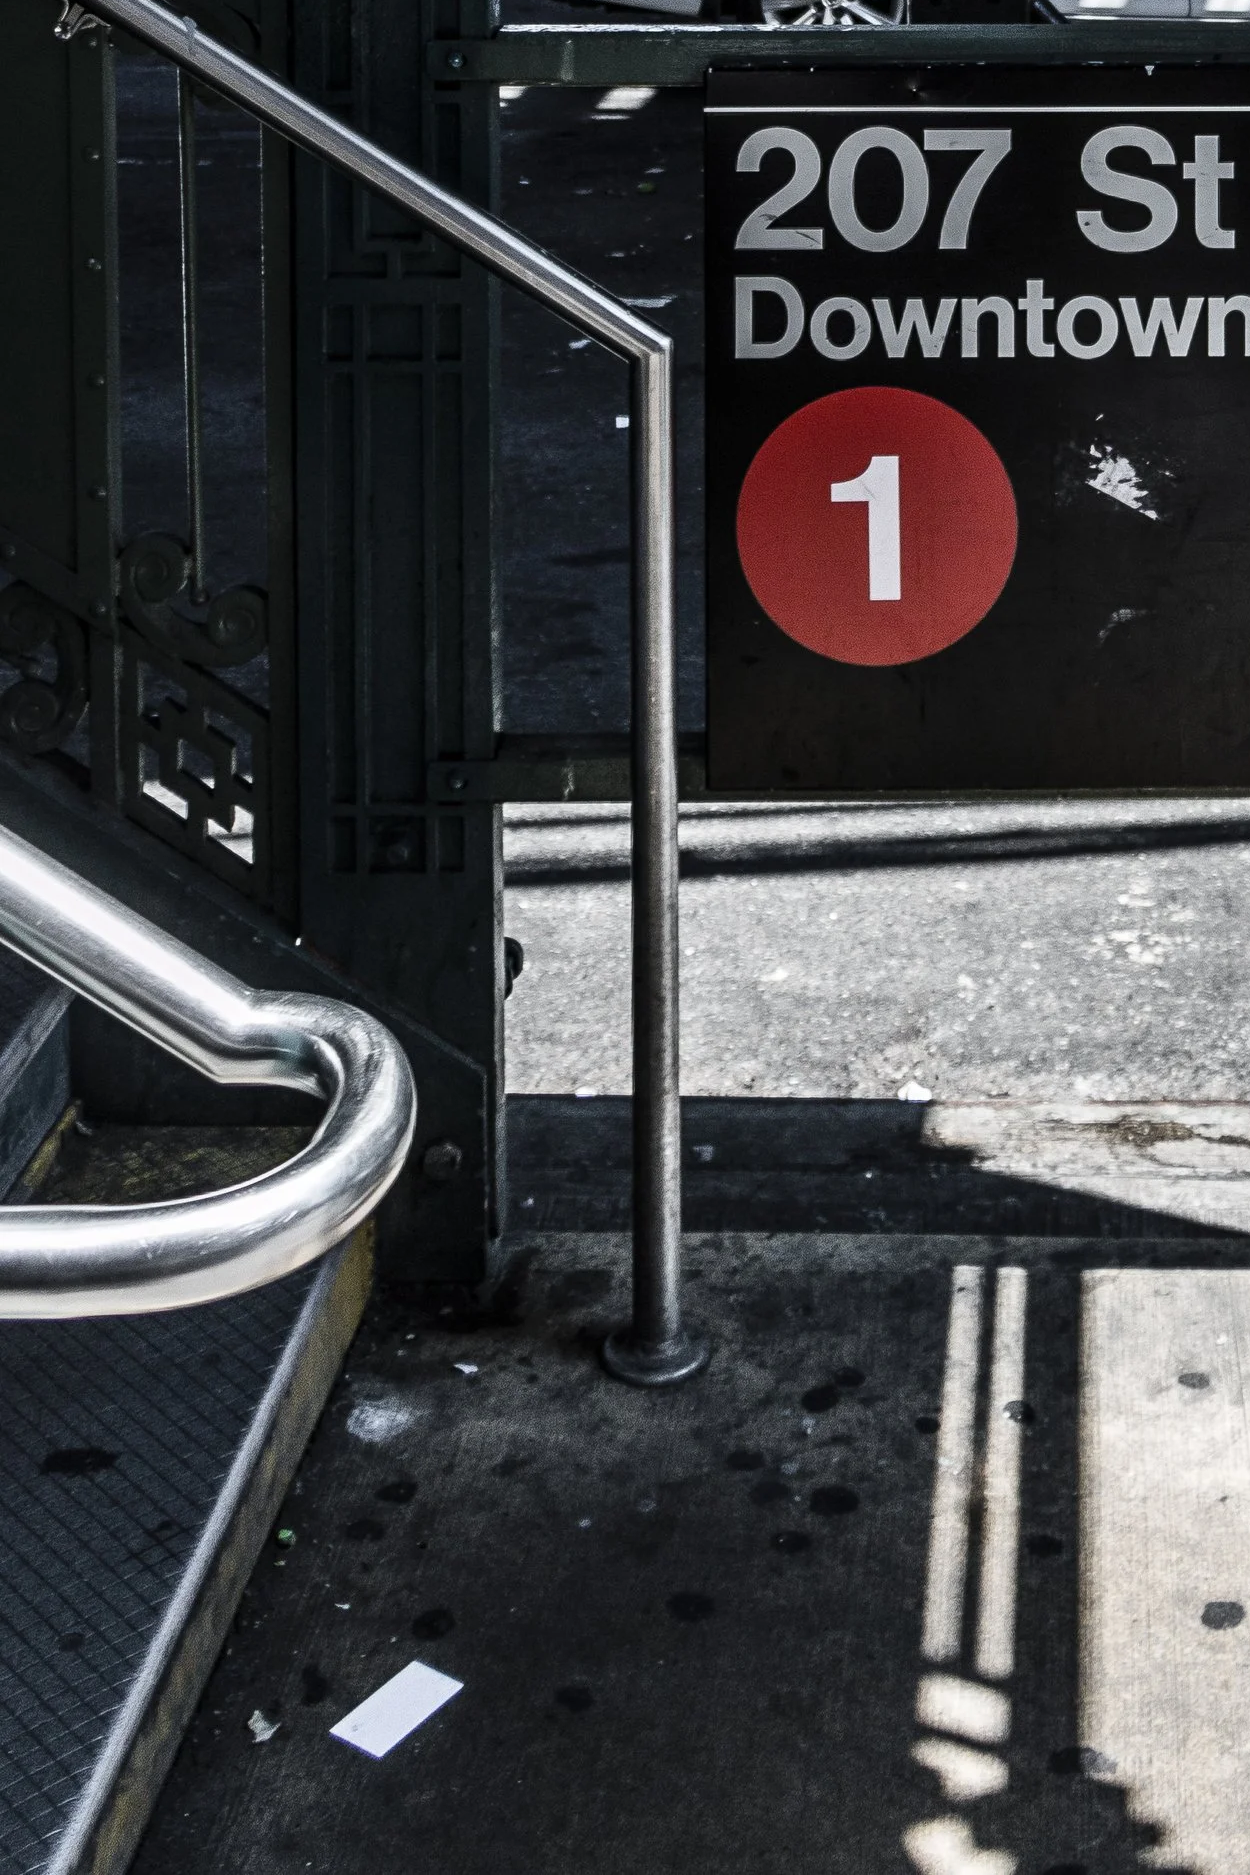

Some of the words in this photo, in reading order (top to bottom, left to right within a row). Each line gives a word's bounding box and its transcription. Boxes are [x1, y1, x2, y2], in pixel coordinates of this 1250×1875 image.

[733, 126, 1012, 253] 207
[1076, 124, 1236, 255] St
[829, 454, 902, 603] 1
